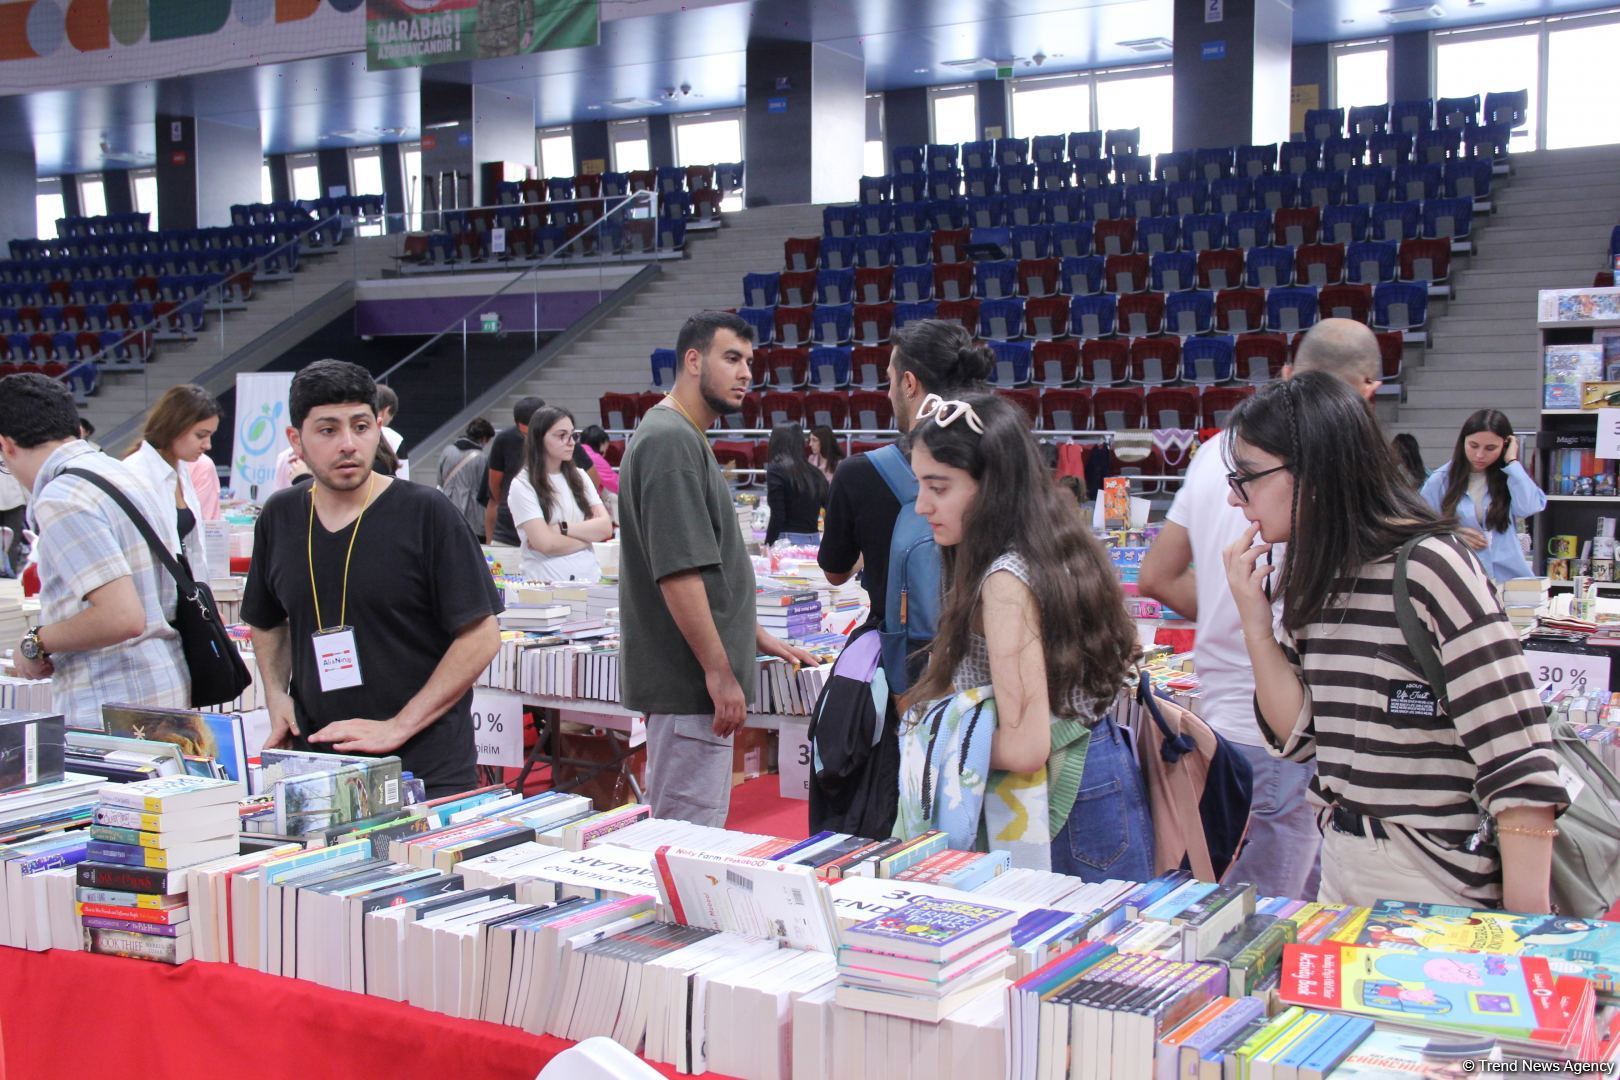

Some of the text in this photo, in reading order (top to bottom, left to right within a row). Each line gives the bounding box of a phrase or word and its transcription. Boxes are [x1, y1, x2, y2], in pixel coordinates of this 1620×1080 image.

[1209, 0, 1218, 11] 2
[1538, 666, 1588, 686] 30 %
[487, 712, 503, 732] %
[570, 856, 656, 877] ABLAR
[697, 851, 722, 862] Farm
[1291, 952, 1318, 995] Activity Book
